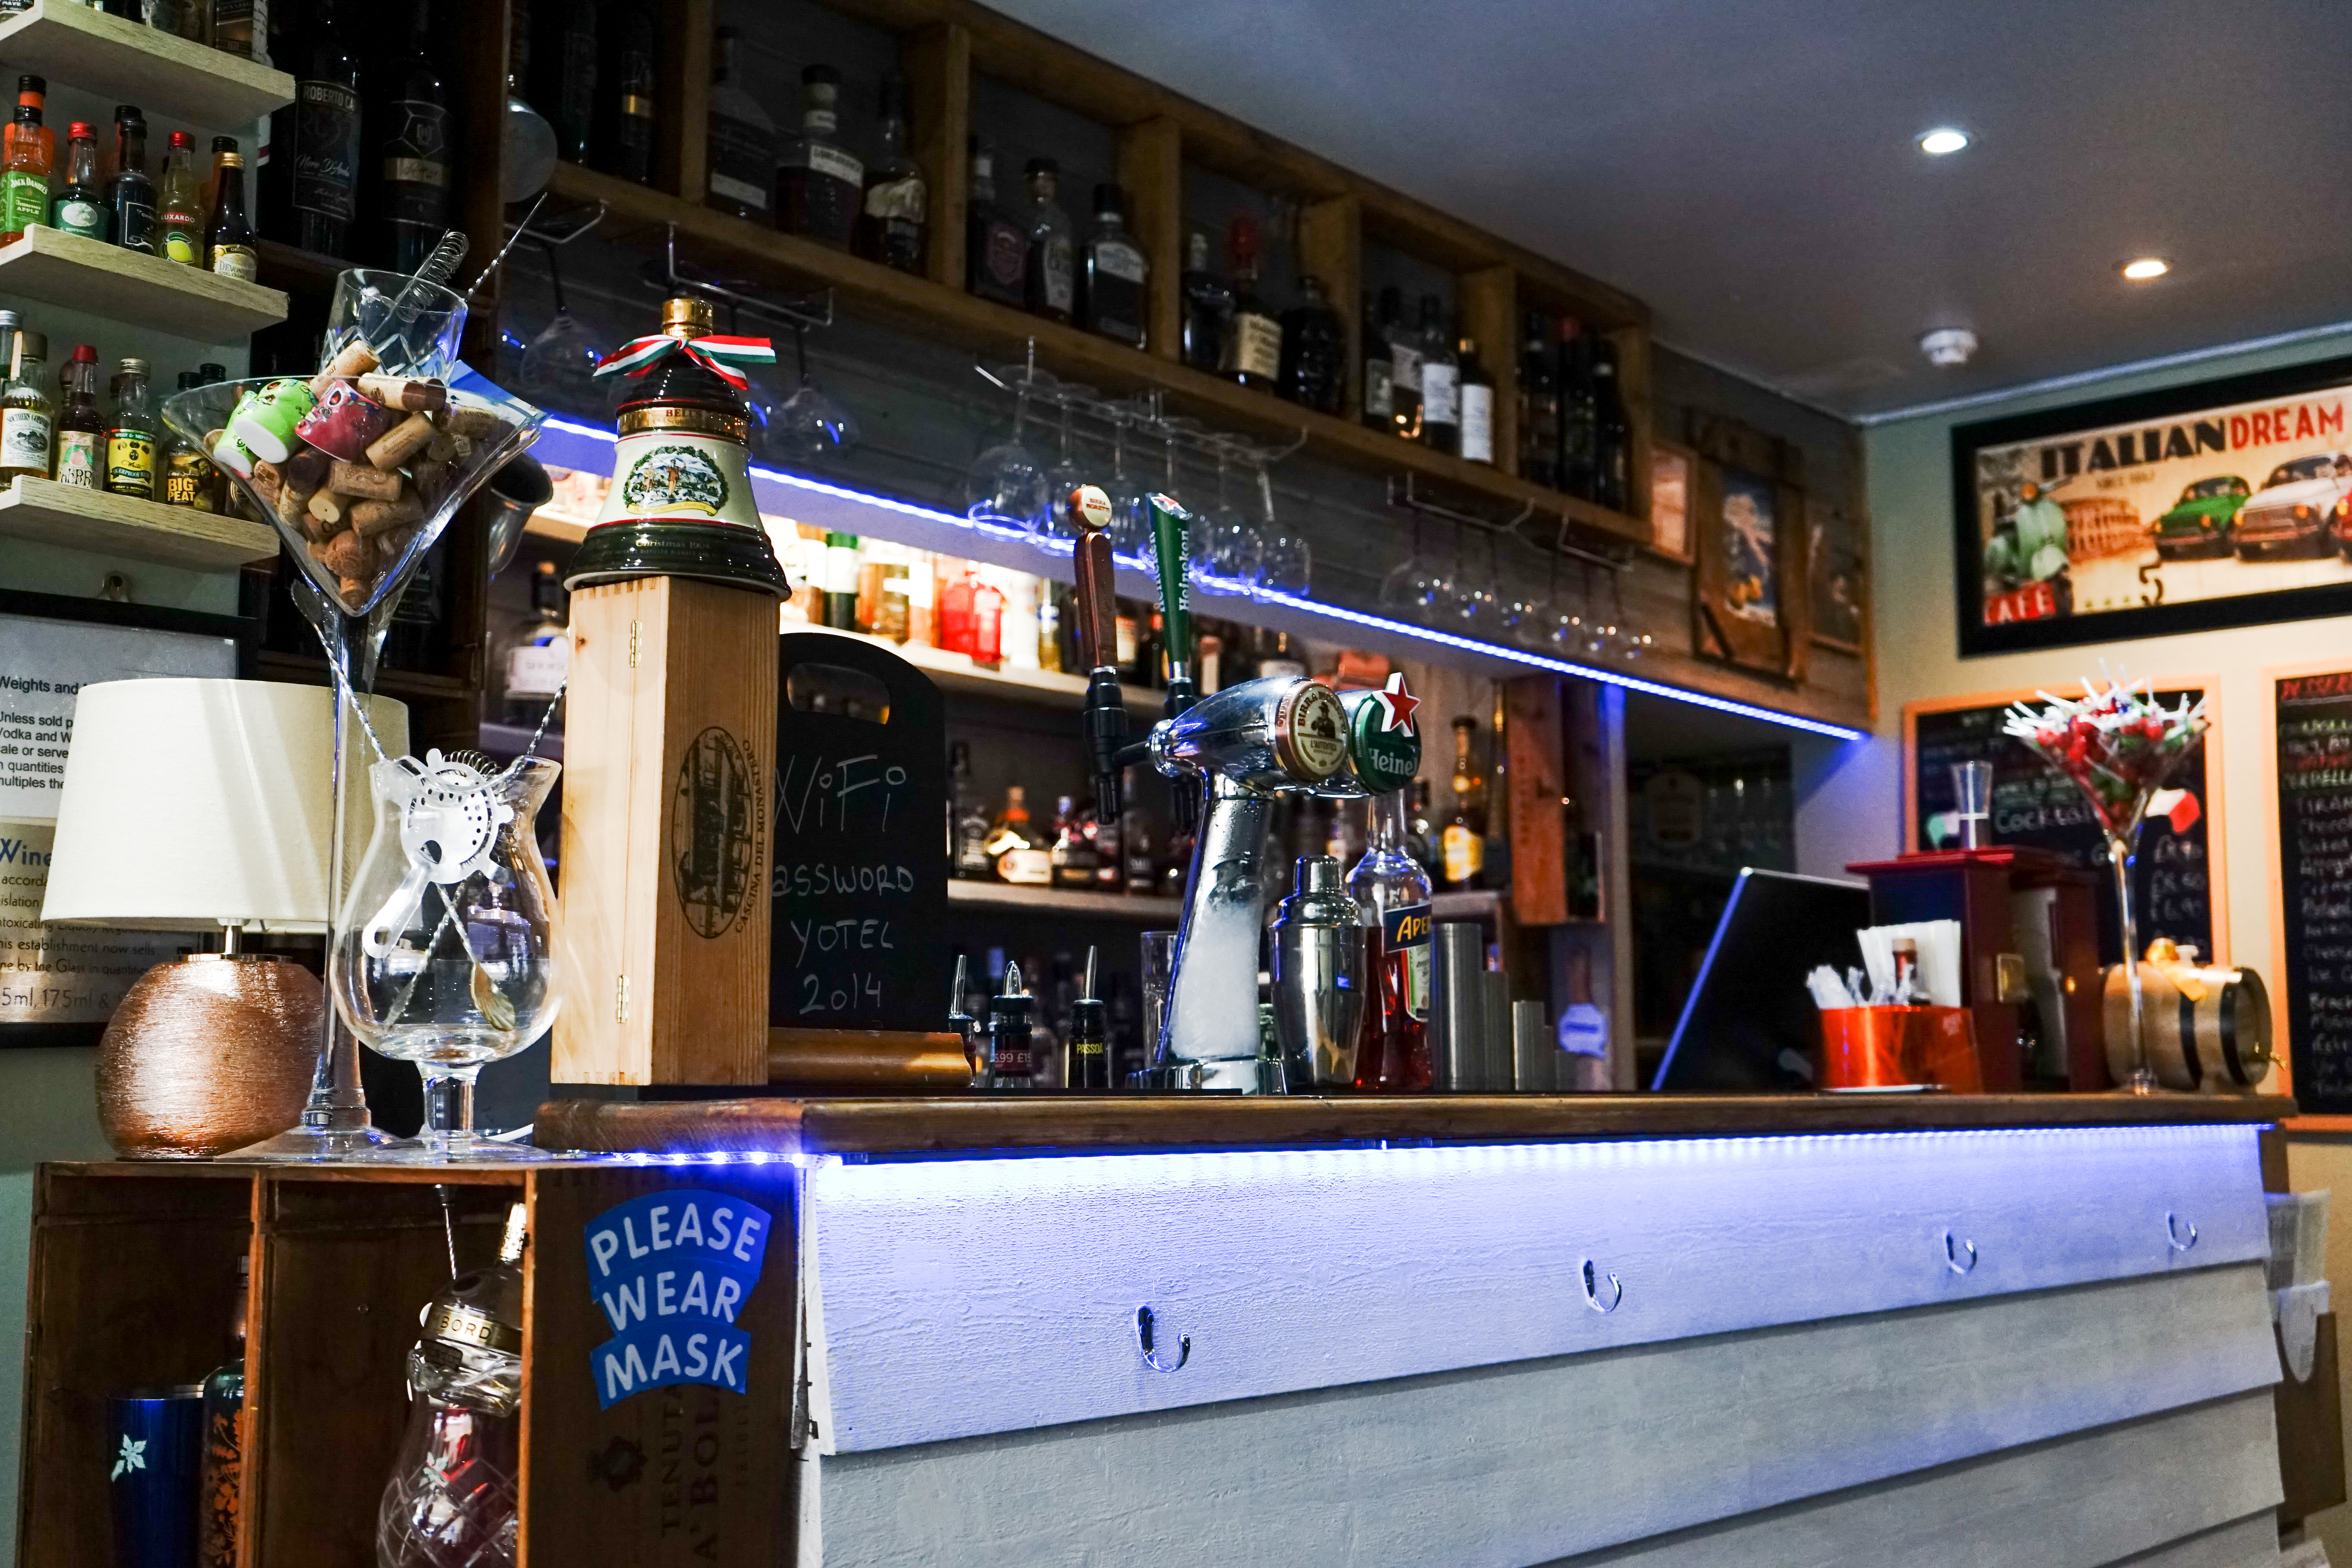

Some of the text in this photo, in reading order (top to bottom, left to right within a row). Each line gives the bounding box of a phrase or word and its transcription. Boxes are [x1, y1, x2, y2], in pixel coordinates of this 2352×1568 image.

[11, 178, 25, 188] JACK
[161, 214, 195, 223] LUXARDO
[2041, 402, 2344, 480] ITALIAN DREAM
[168, 477, 193, 491] BIG
[167, 491, 196, 501] PEAT
[1178, 530, 1189, 611] Heineken
[0, 675, 78, 695] Weights and
[38, 715, 62, 727] sold
[35, 731, 57, 742] and
[22, 747, 34, 756] or
[8, 762, 64, 774] quantities
[735, 740, 765, 933] CASCINA DEL MONASTERO
[17, 937, 98, 953] establishment
[102, 945, 128, 954] now
[132, 942, 155, 955] sells
[790, 919, 894, 969] YOTEL
[17, 957, 31, 973] by
[34, 961, 53, 972] the
[55, 958, 86, 974] Glass
[42, 988, 93, 1009] 175ml
[799, 973, 882, 1014] 2014
[590, 1203, 761, 1277] PLEASE
[603, 1271, 741, 1332] WEAR
[604, 1333, 743, 1399] MASK
